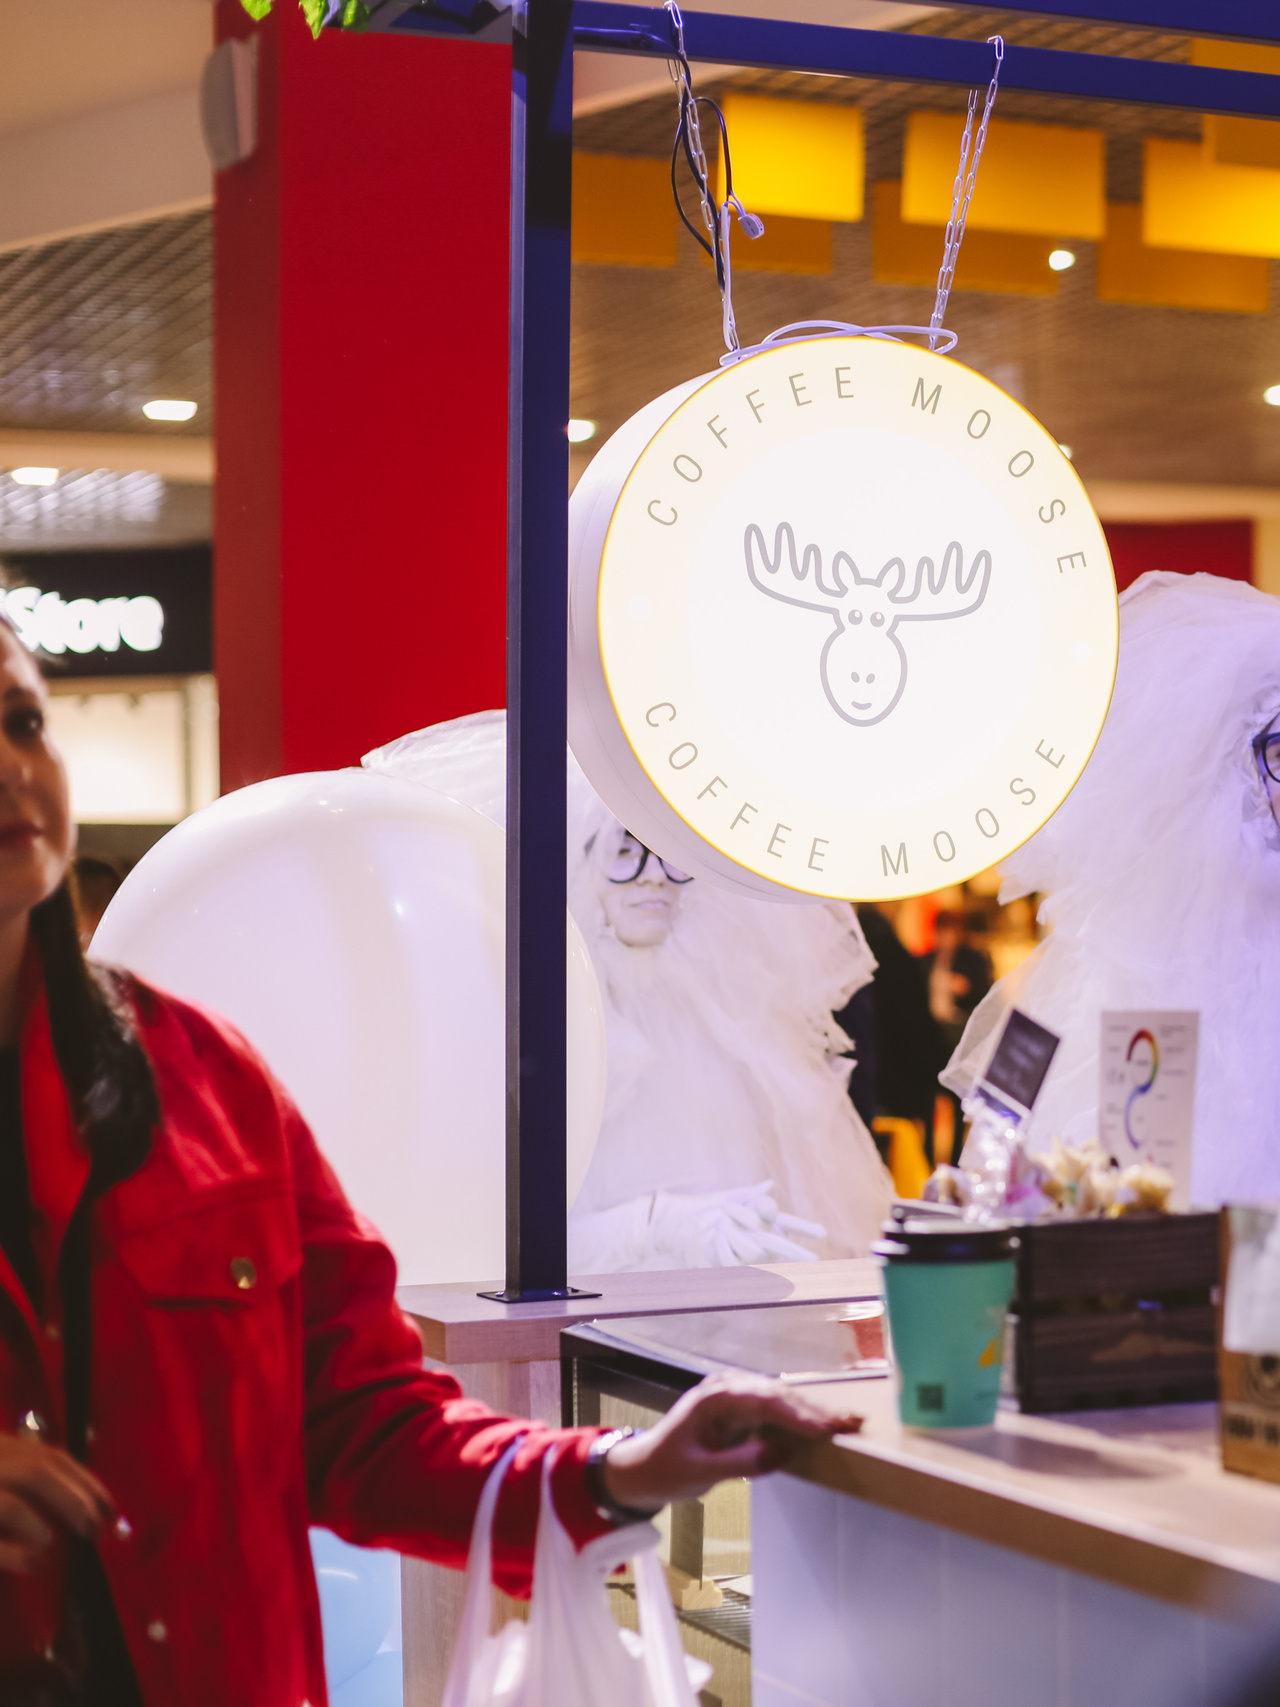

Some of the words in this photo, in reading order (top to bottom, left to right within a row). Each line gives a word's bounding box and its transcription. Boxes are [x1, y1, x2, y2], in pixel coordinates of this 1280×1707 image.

[647, 366, 854, 526] COFFEE
[911, 376, 1088, 575] MOOSE
[645, 701, 830, 872] COFFEE
[880, 738, 1067, 878] MOOSE
